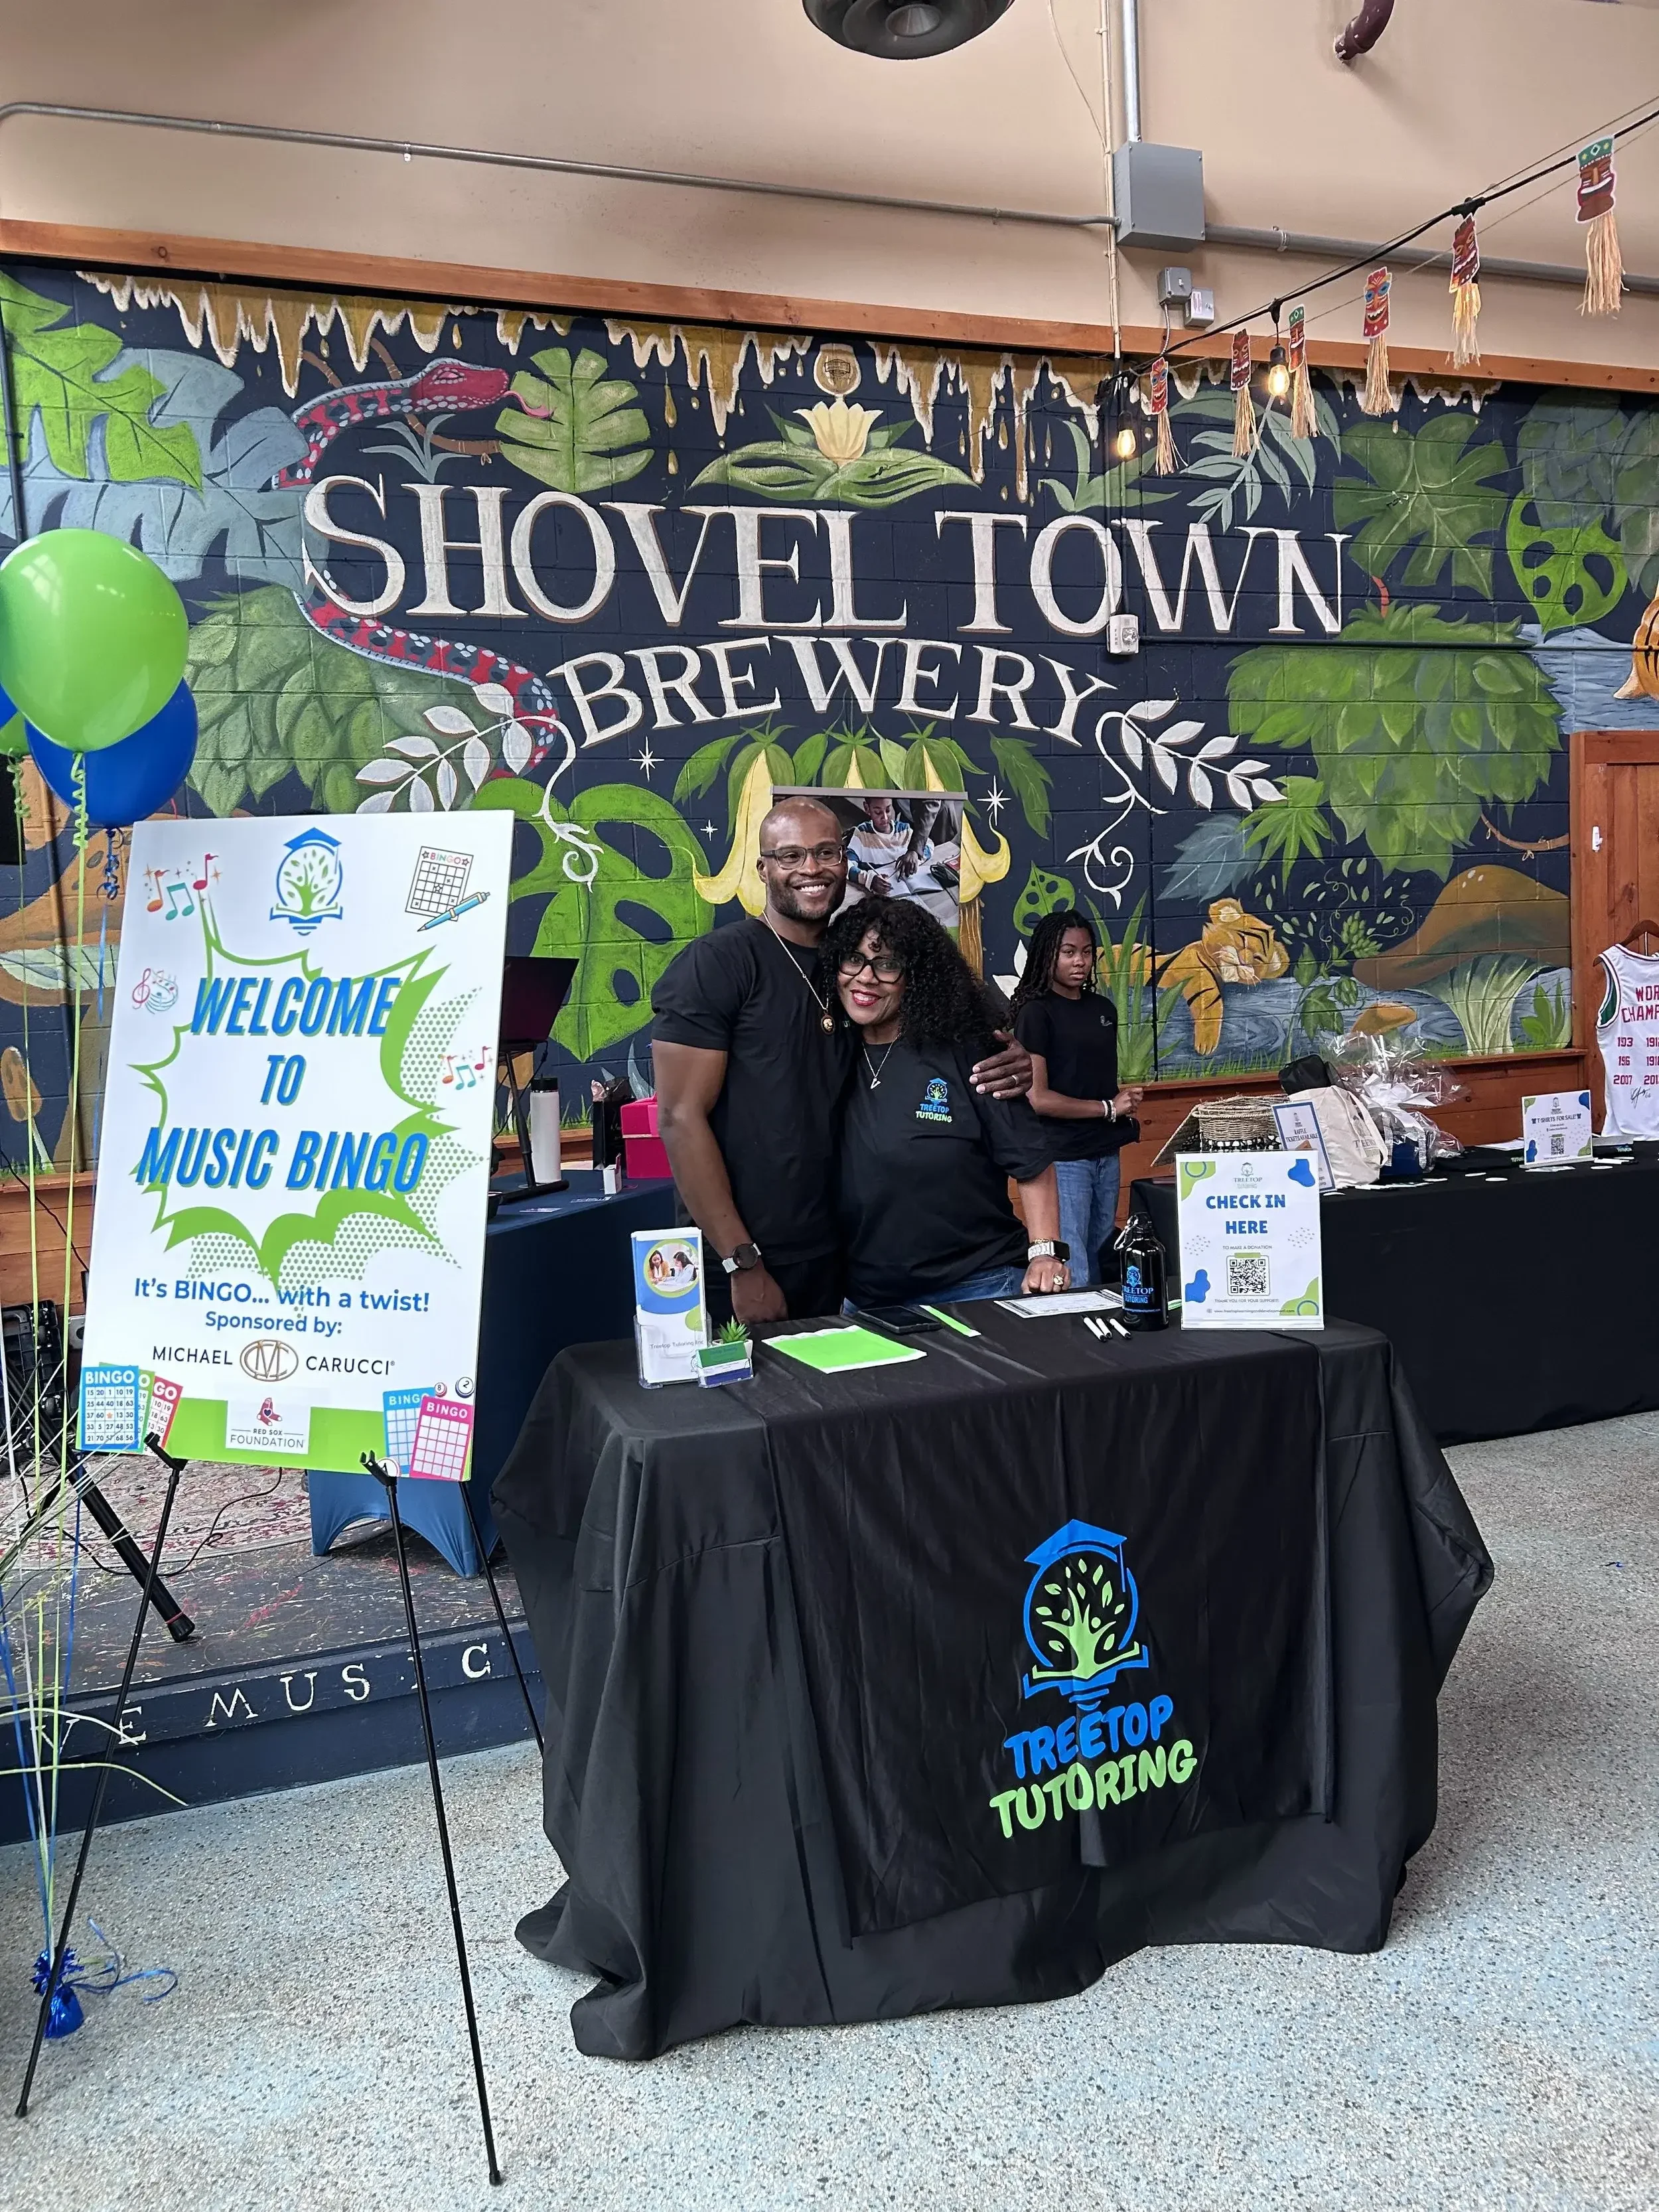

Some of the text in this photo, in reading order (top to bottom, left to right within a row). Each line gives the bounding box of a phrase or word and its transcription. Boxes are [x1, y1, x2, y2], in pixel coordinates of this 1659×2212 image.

[304, 473, 1352, 636] SHOVEL TOWN
[546, 636, 1118, 749] BREWERY
[430, 852, 461, 865] BINGO
[190, 976, 401, 1037] WELCOME
[259, 1054, 307, 1106] TO
[1613, 1074, 1632, 1084] 2007
[916, 1110, 953, 1123] TUTORING
[920, 1103, 950, 1114] TREETOP
[135, 1126, 430, 1195] MUSIC BINGO
[1206, 1195, 1285, 1209] CHECK IN
[1226, 1220, 1268, 1234] HERE
[175, 1280, 269, 1303] BINGO...
[277, 1284, 330, 1307] with
[338, 1292, 352, 1308] a
[360, 1289, 429, 1312] twist!
[1121, 1285, 1154, 1295] TREETOP
[206, 1311, 342, 1337] Sponsored by:
[153, 1346, 233, 1365] MICHAEL
[85, 1370, 135, 1384] BINGO
[426, 1402, 467, 1418] BINGO
[230, 1435, 305, 1448] FOUNDATION
[1004, 1695, 1174, 1779] TREETOP
[990, 1739, 1197, 1838] TUTORING
